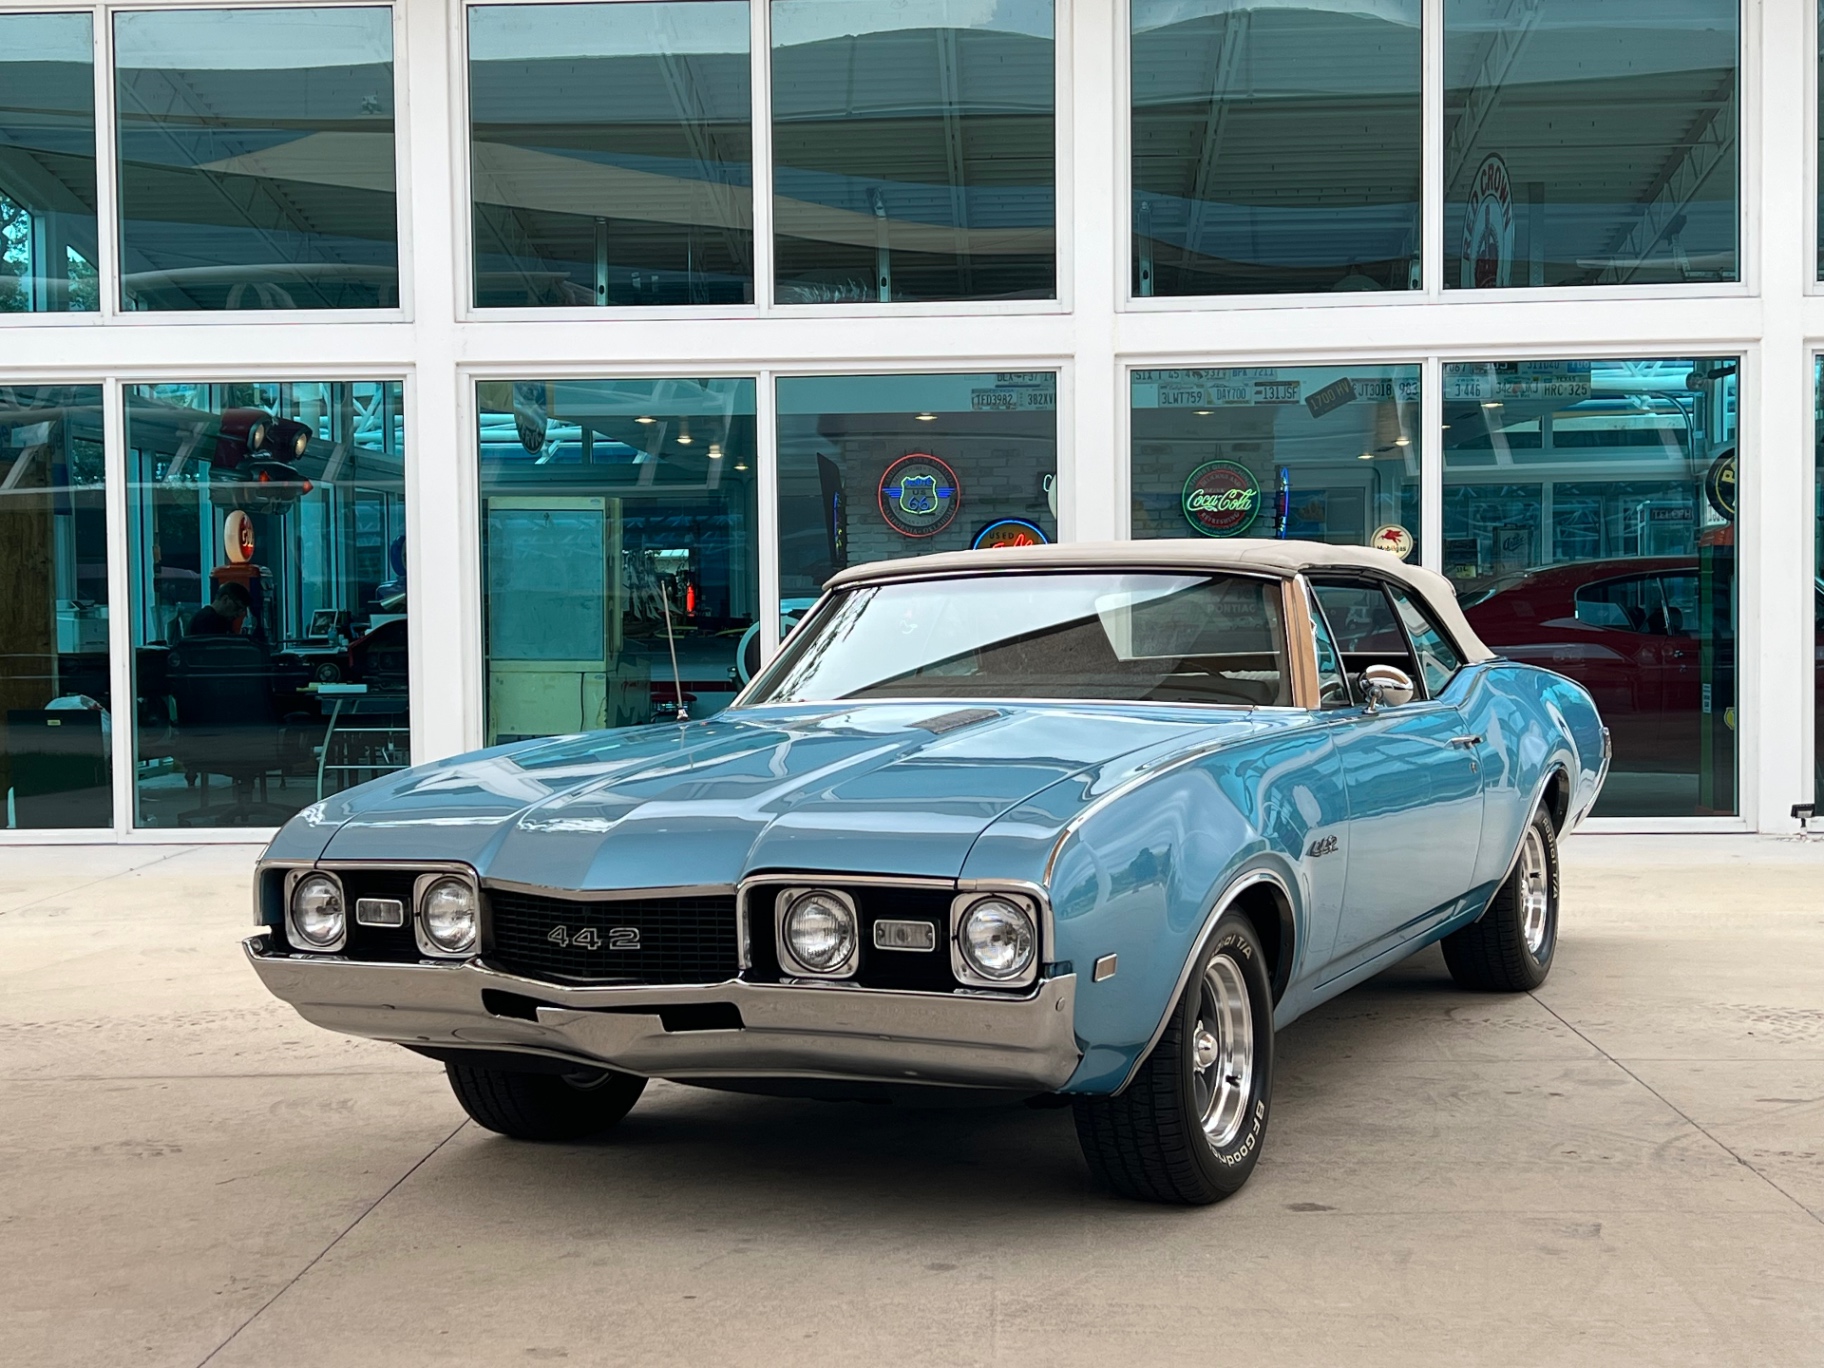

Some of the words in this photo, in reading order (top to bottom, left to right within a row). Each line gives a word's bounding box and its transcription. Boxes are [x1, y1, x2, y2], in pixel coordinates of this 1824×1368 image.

[1481, 163, 1511, 232] CROWN
[1544, 384, 1563, 396] HRC
[1568, 384, 1587, 396] 325
[1027, 393, 1055, 406] 382XV
[1161, 391, 1203, 405] 3LWT759
[908, 496, 931, 511] 66
[1187, 488, 1258, 512] Coca-Cola
[989, 532, 1015, 540] USED
[1207, 603, 1256, 614] PONTIAC
[547, 925, 641, 950] 442
[1236, 936, 1253, 960] T/A
